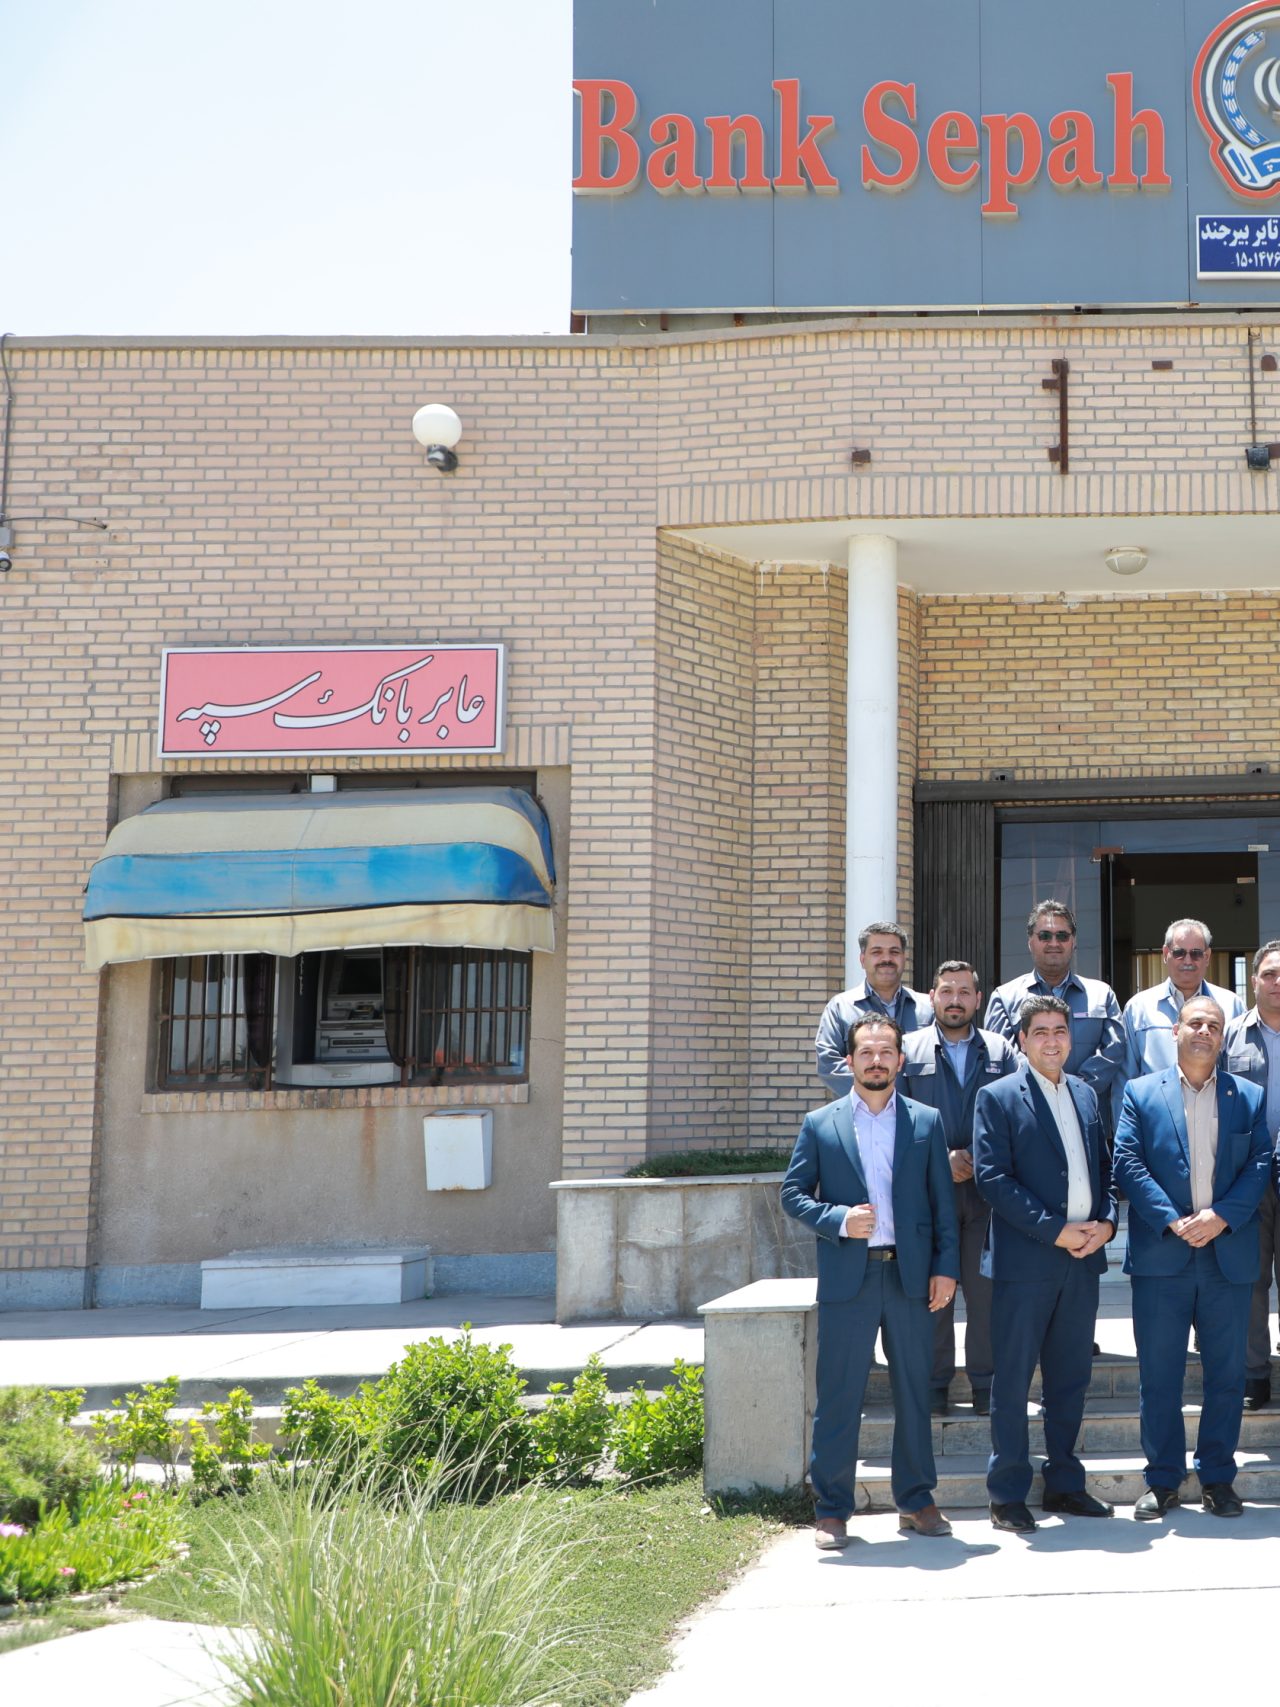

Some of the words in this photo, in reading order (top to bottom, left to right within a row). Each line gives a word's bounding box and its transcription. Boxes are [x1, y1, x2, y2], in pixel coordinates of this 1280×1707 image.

[572, 78, 840, 192] Bank
[861, 72, 1172, 216] Sepah
[1201, 221, 1250, 247] بیرجند
[176, 671, 322, 746] سپه
[273, 655, 434, 743] بانک
[418, 674, 485, 740] عابر
